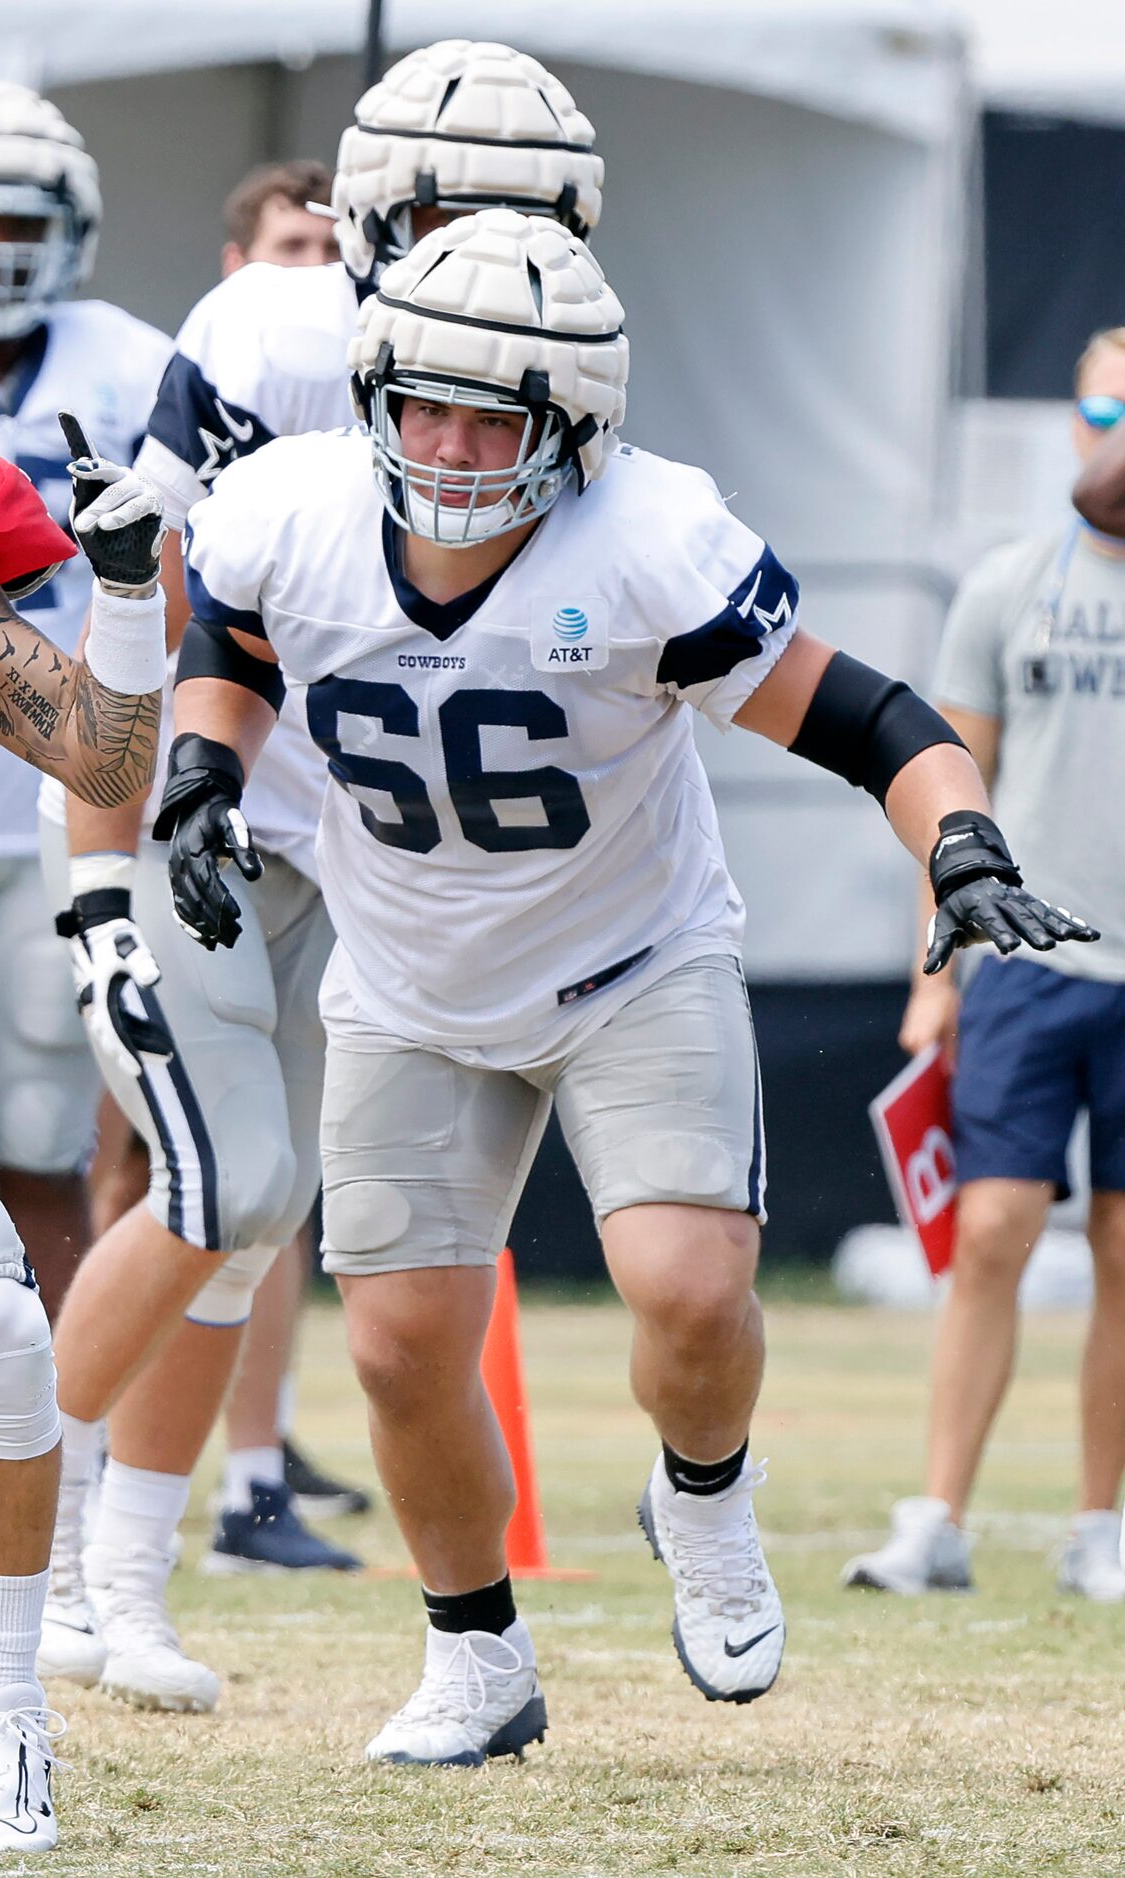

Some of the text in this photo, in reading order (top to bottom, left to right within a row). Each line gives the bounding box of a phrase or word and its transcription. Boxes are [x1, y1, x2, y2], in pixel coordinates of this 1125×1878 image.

[397, 654, 466, 669] COWBOYS
[548, 647, 593, 662] AT&T
[306, 673, 591, 854] 66
[906, 1125, 956, 1225] B
